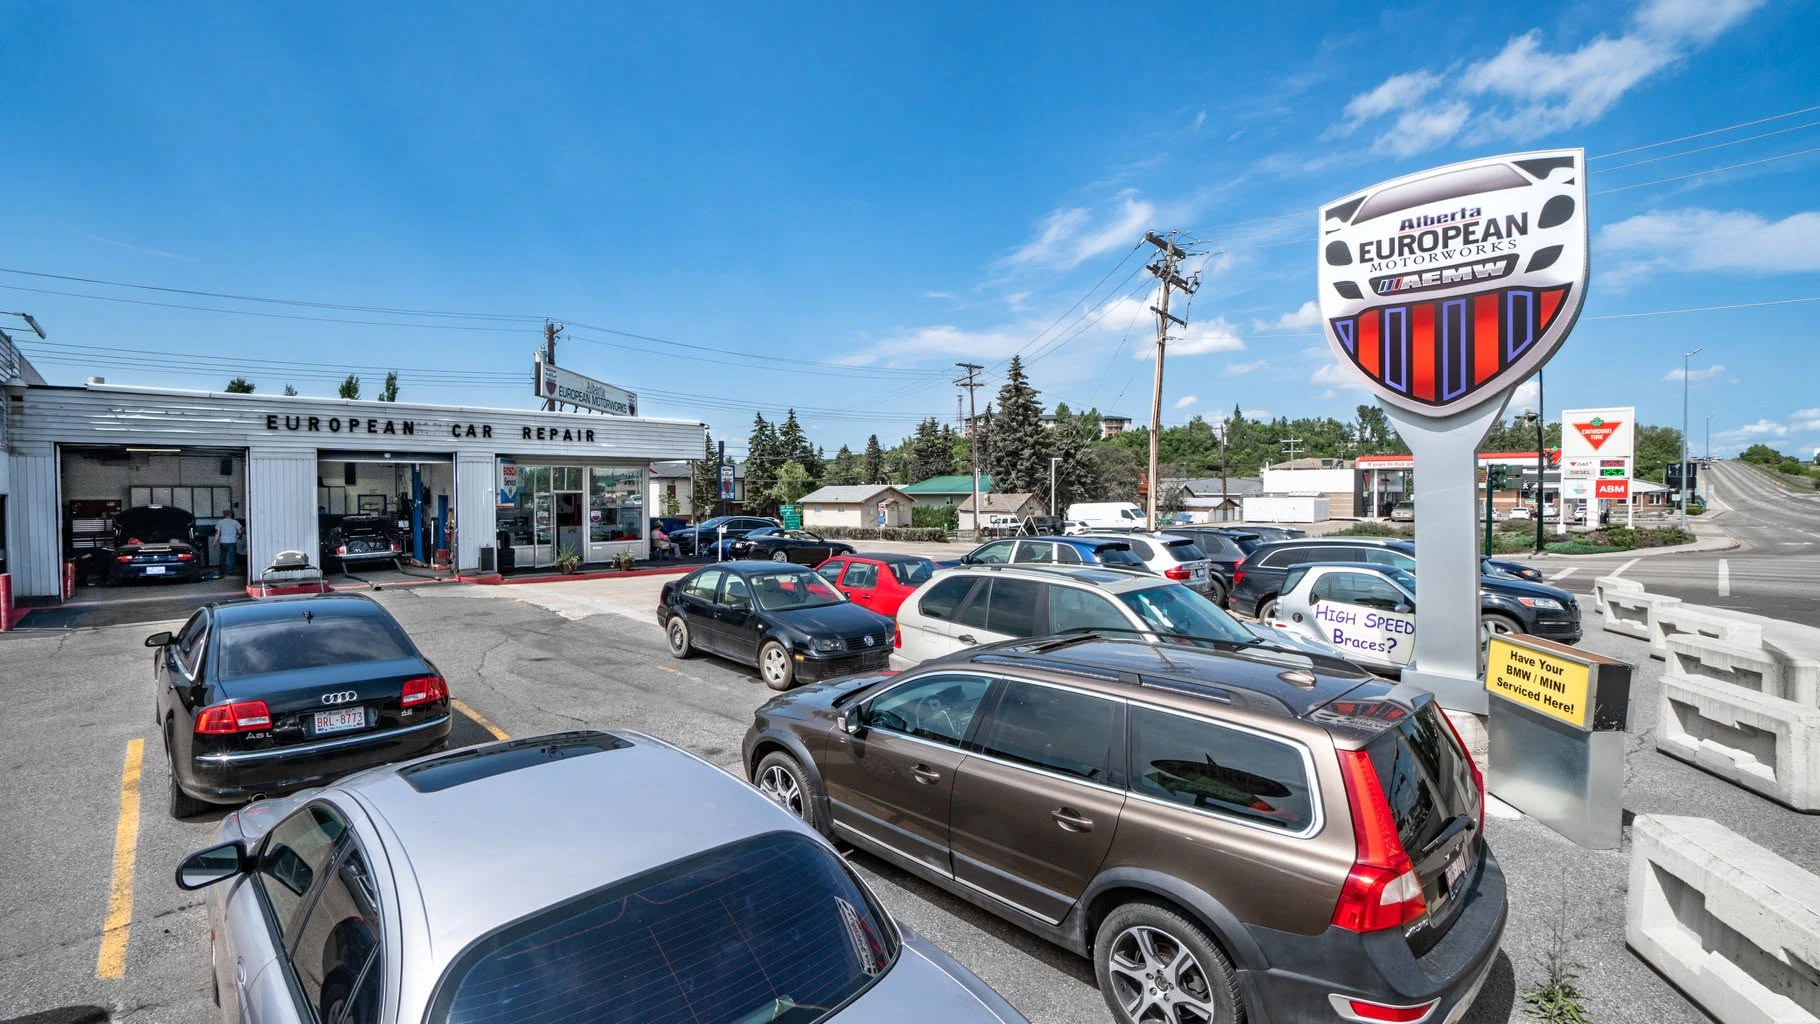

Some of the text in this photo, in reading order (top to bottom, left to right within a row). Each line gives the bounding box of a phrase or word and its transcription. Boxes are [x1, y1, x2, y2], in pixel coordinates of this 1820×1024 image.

[1399, 207, 1482, 231] Alberta
[1359, 211, 1528, 264] EUROPEAN
[1369, 239, 1517, 273] MOTORWORKS
[559, 386, 627, 414] EUROPEAN MOTORWORKS
[266, 415, 595, 442] EUROPEAN CAR REPAIR
[1600, 485, 1625, 493] ABM
[1315, 604, 1415, 635] HIGH SPEED
[1333, 628, 1398, 654] Braces?
[1510, 650, 1564, 676] Have Your
[1506, 665, 1531, 681] BMW
[1539, 675, 1566, 694] MINI
[1496, 677, 1574, 714] Serviced Here!
